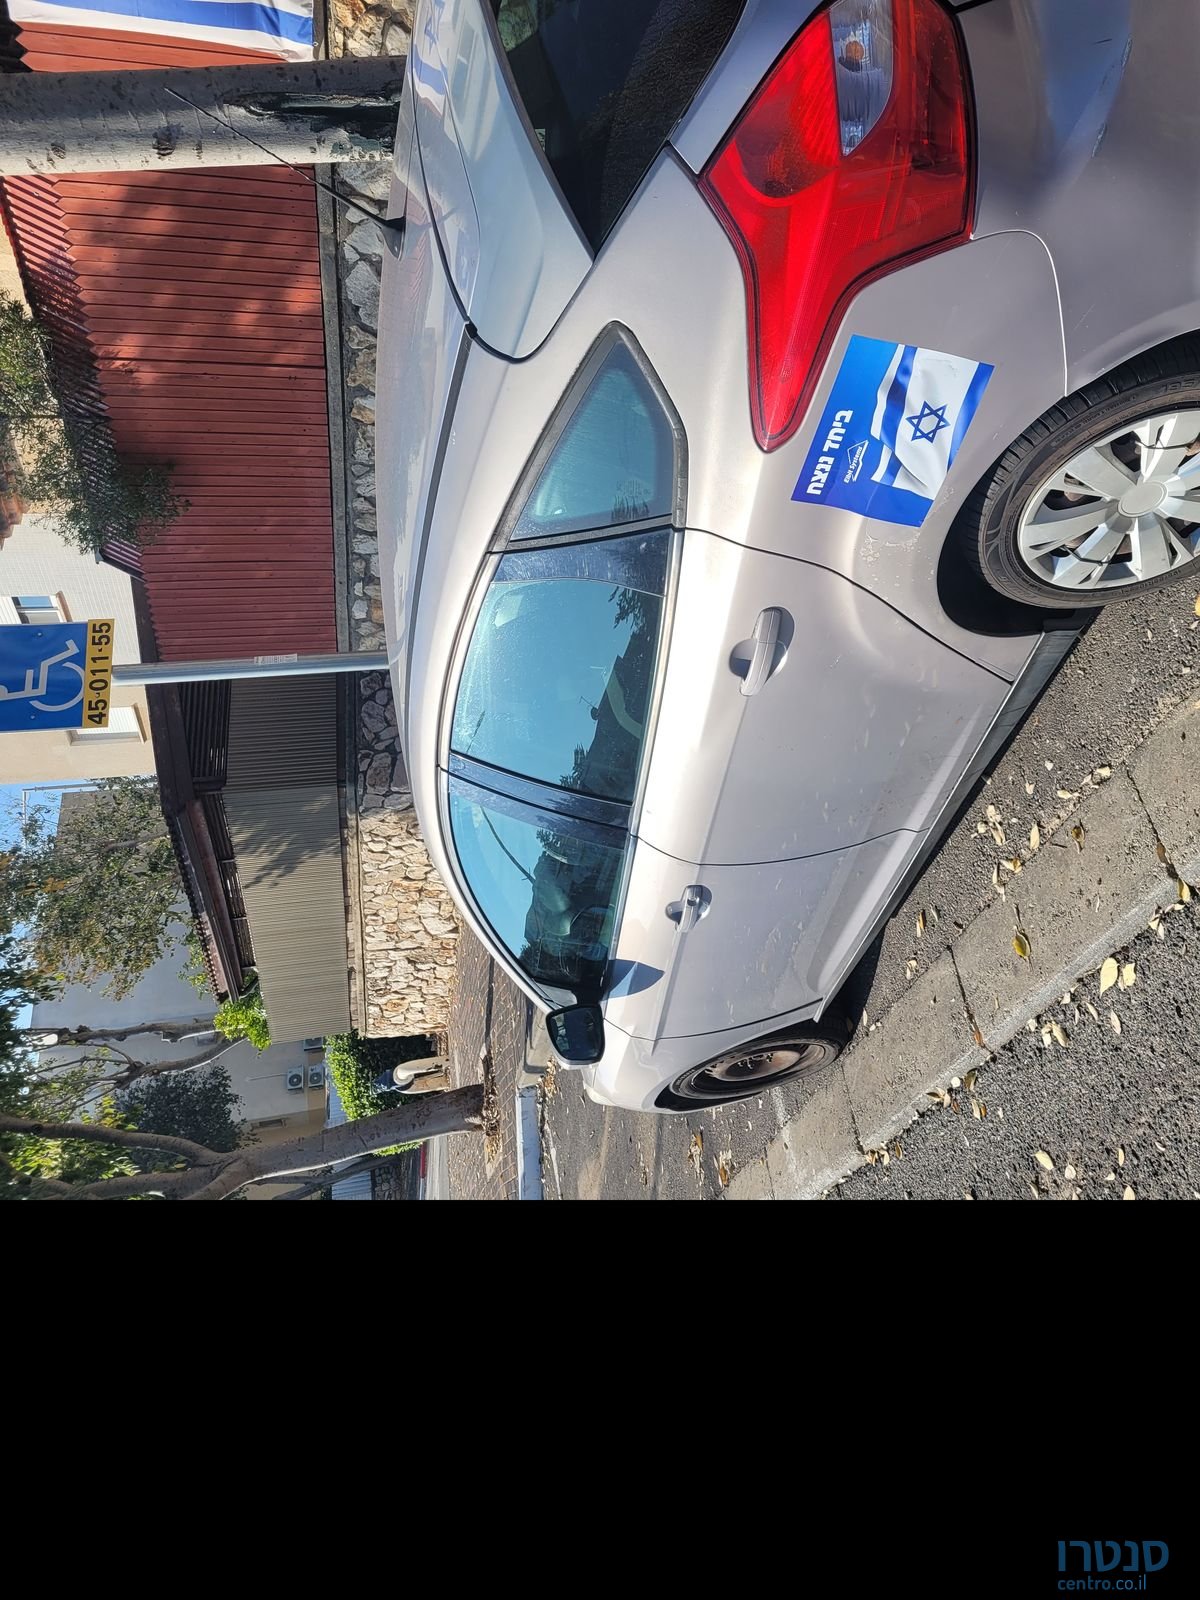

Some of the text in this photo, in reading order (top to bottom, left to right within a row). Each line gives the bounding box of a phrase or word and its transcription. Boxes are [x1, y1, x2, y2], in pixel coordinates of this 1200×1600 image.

[806, 409, 854, 495] ביחד ננצח
[843, 469, 854, 484] Elbit
[87, 622, 111, 725] 45-011-55
